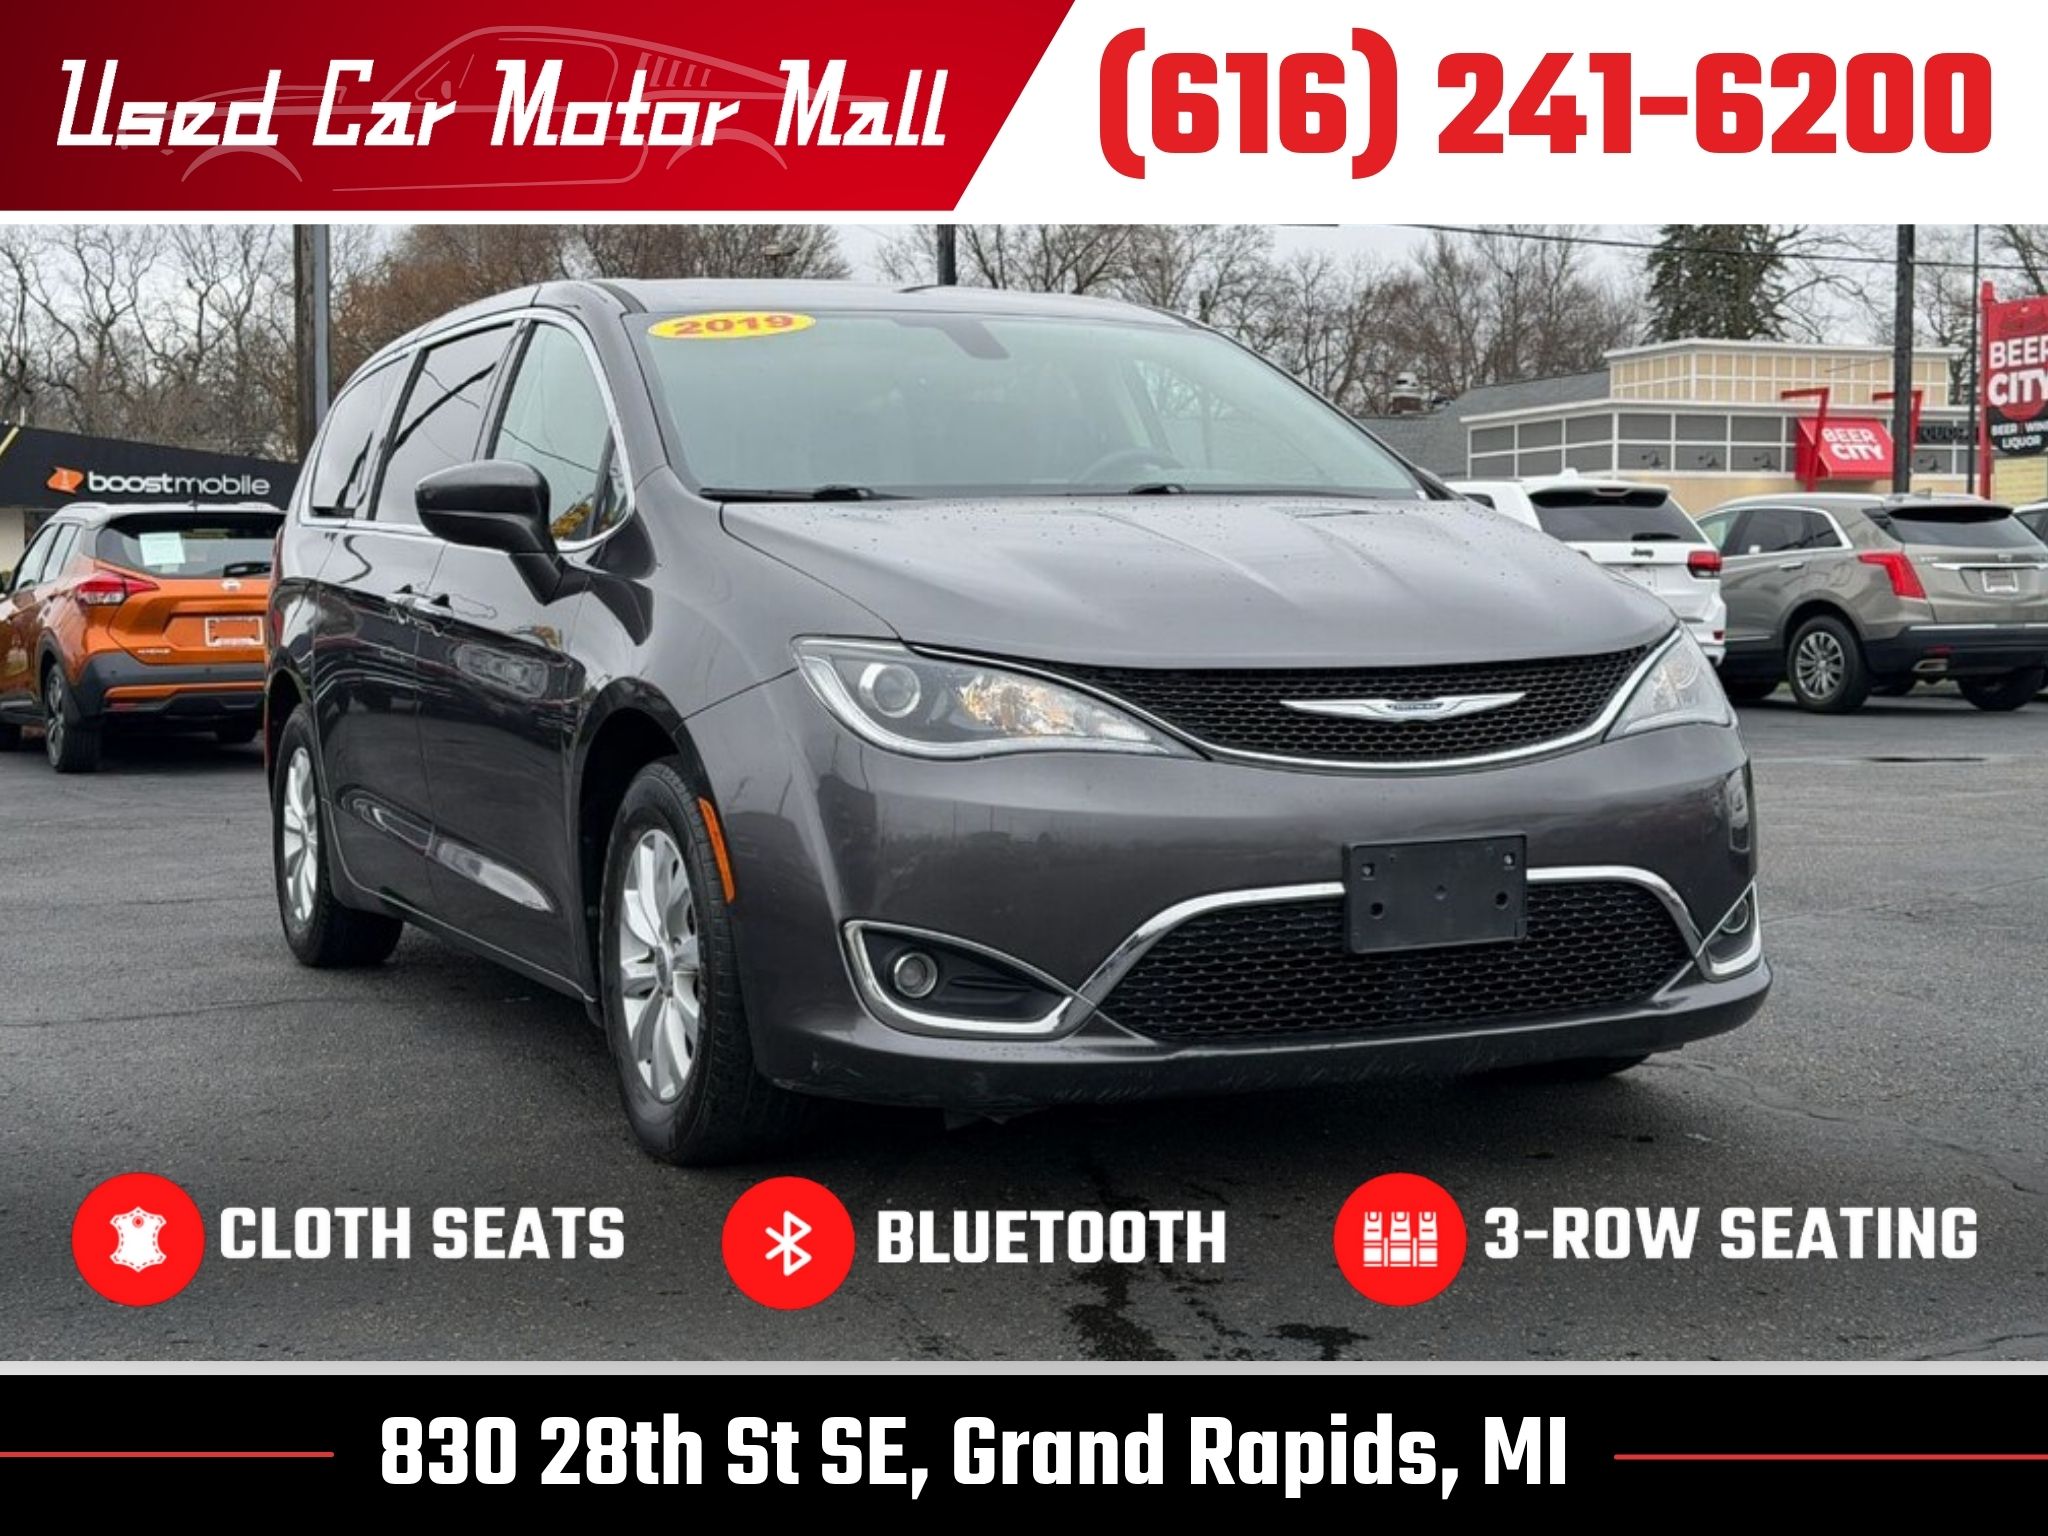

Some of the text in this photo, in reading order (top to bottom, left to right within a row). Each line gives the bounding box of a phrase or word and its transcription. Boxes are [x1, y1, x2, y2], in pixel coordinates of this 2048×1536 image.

[674, 315, 793, 335] 2019
[1822, 428, 1877, 443] BEER
[2002, 435, 2041, 450] LIQUOR
[1831, 443, 1884, 460] CITY
[88, 471, 271, 495] boostmobile
